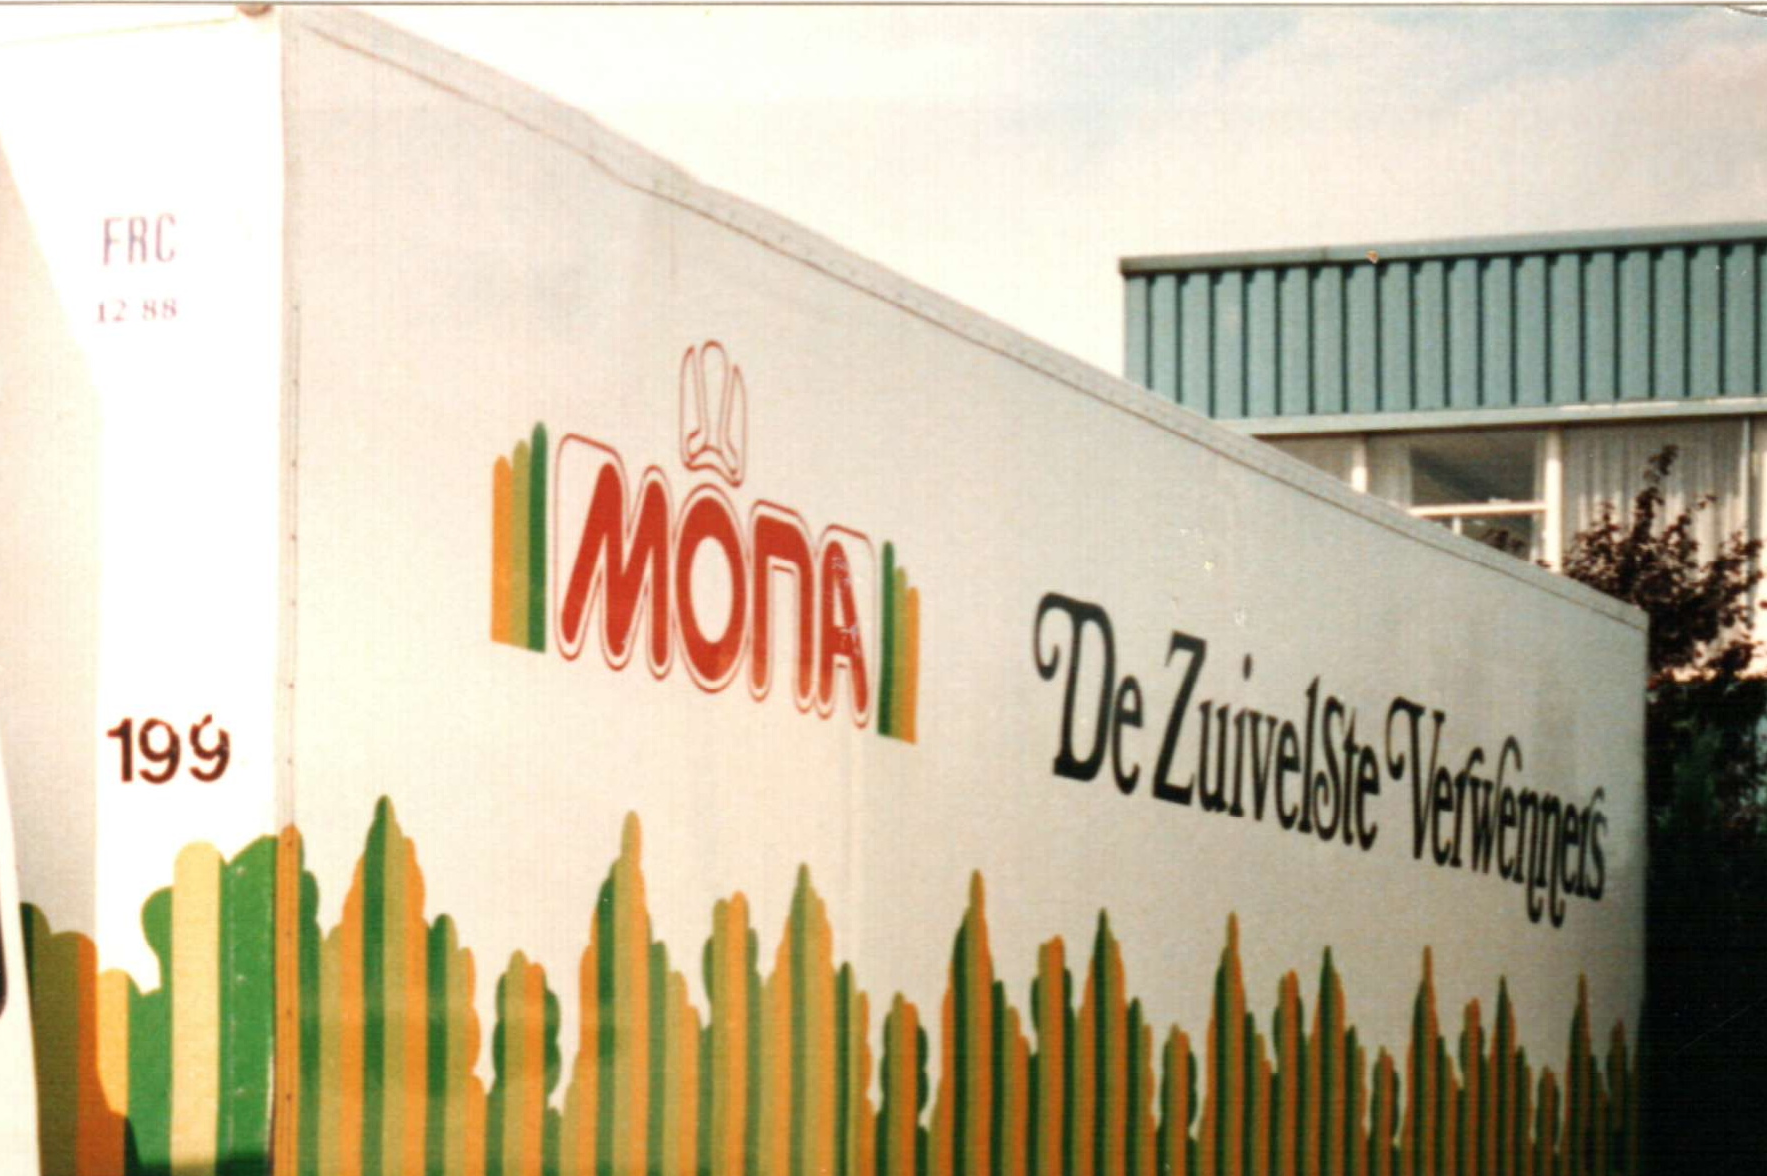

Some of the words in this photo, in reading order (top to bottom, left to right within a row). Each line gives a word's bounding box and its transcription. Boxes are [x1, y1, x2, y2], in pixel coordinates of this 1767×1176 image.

[103, 212, 176, 265] FRC
[1033, 592, 1143, 795] De
[106, 714, 231, 784] 199
